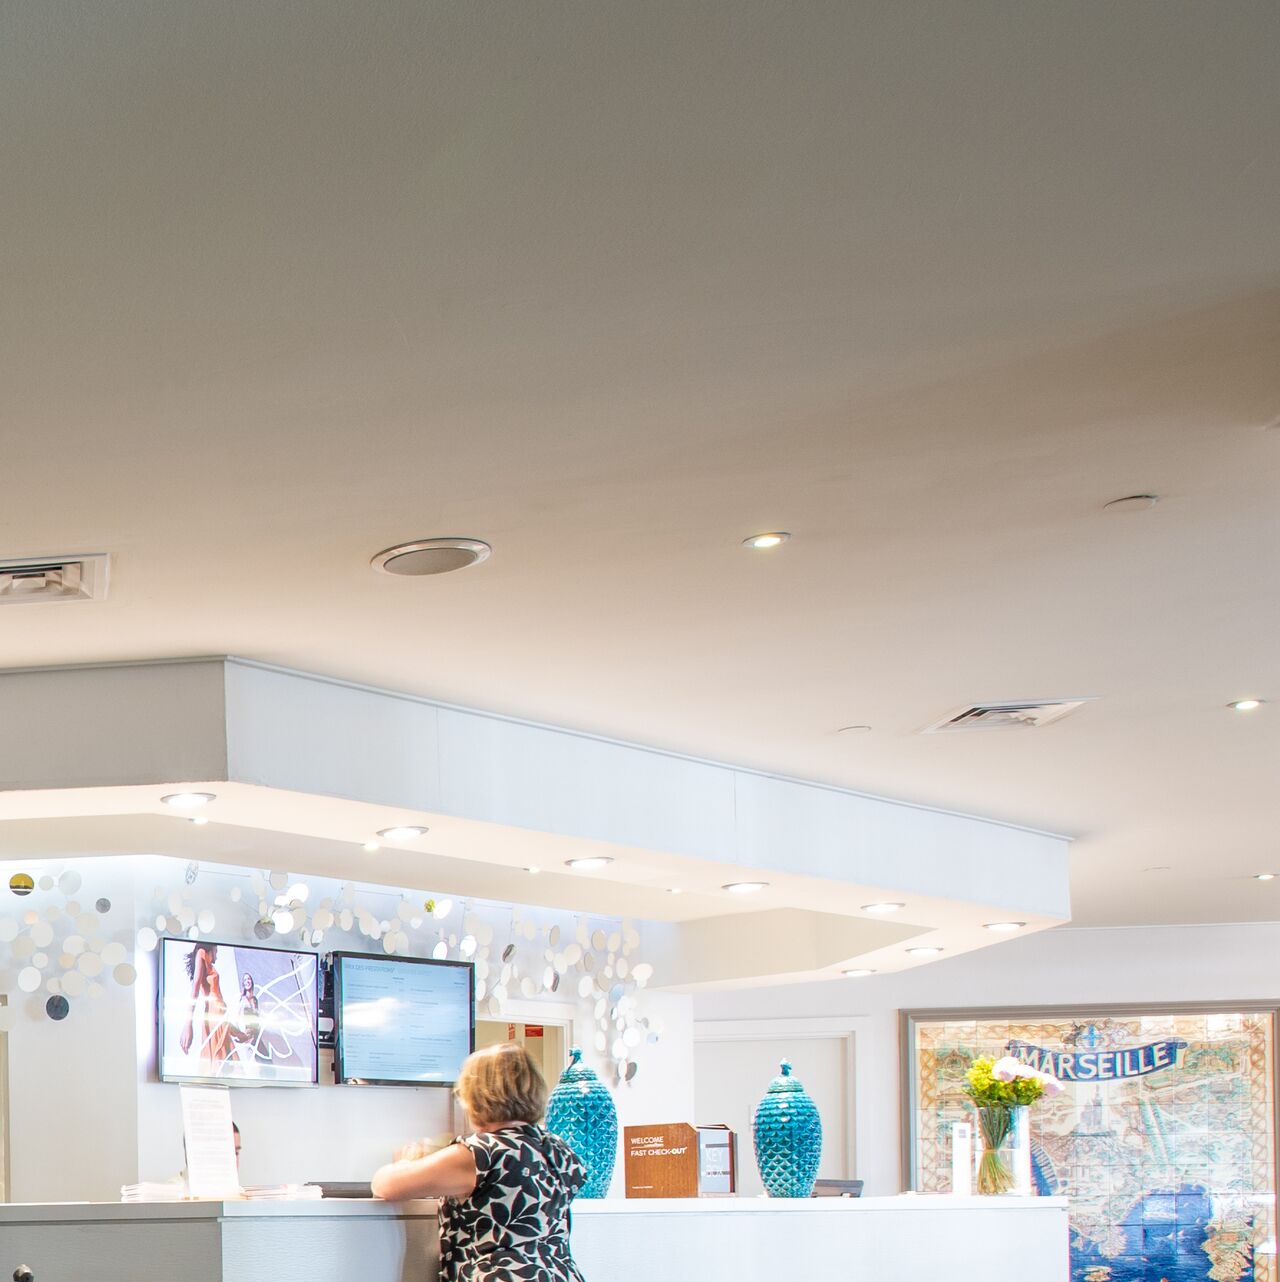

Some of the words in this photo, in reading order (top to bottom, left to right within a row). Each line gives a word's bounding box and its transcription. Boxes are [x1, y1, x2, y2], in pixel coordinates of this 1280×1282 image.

[1019, 1042, 1169, 1080] MARSEILLE
[630, 1136, 664, 1144] WELCOME
[630, 1148, 647, 1157] FAST
[647, 1146, 688, 1156] CHECK-OUT
